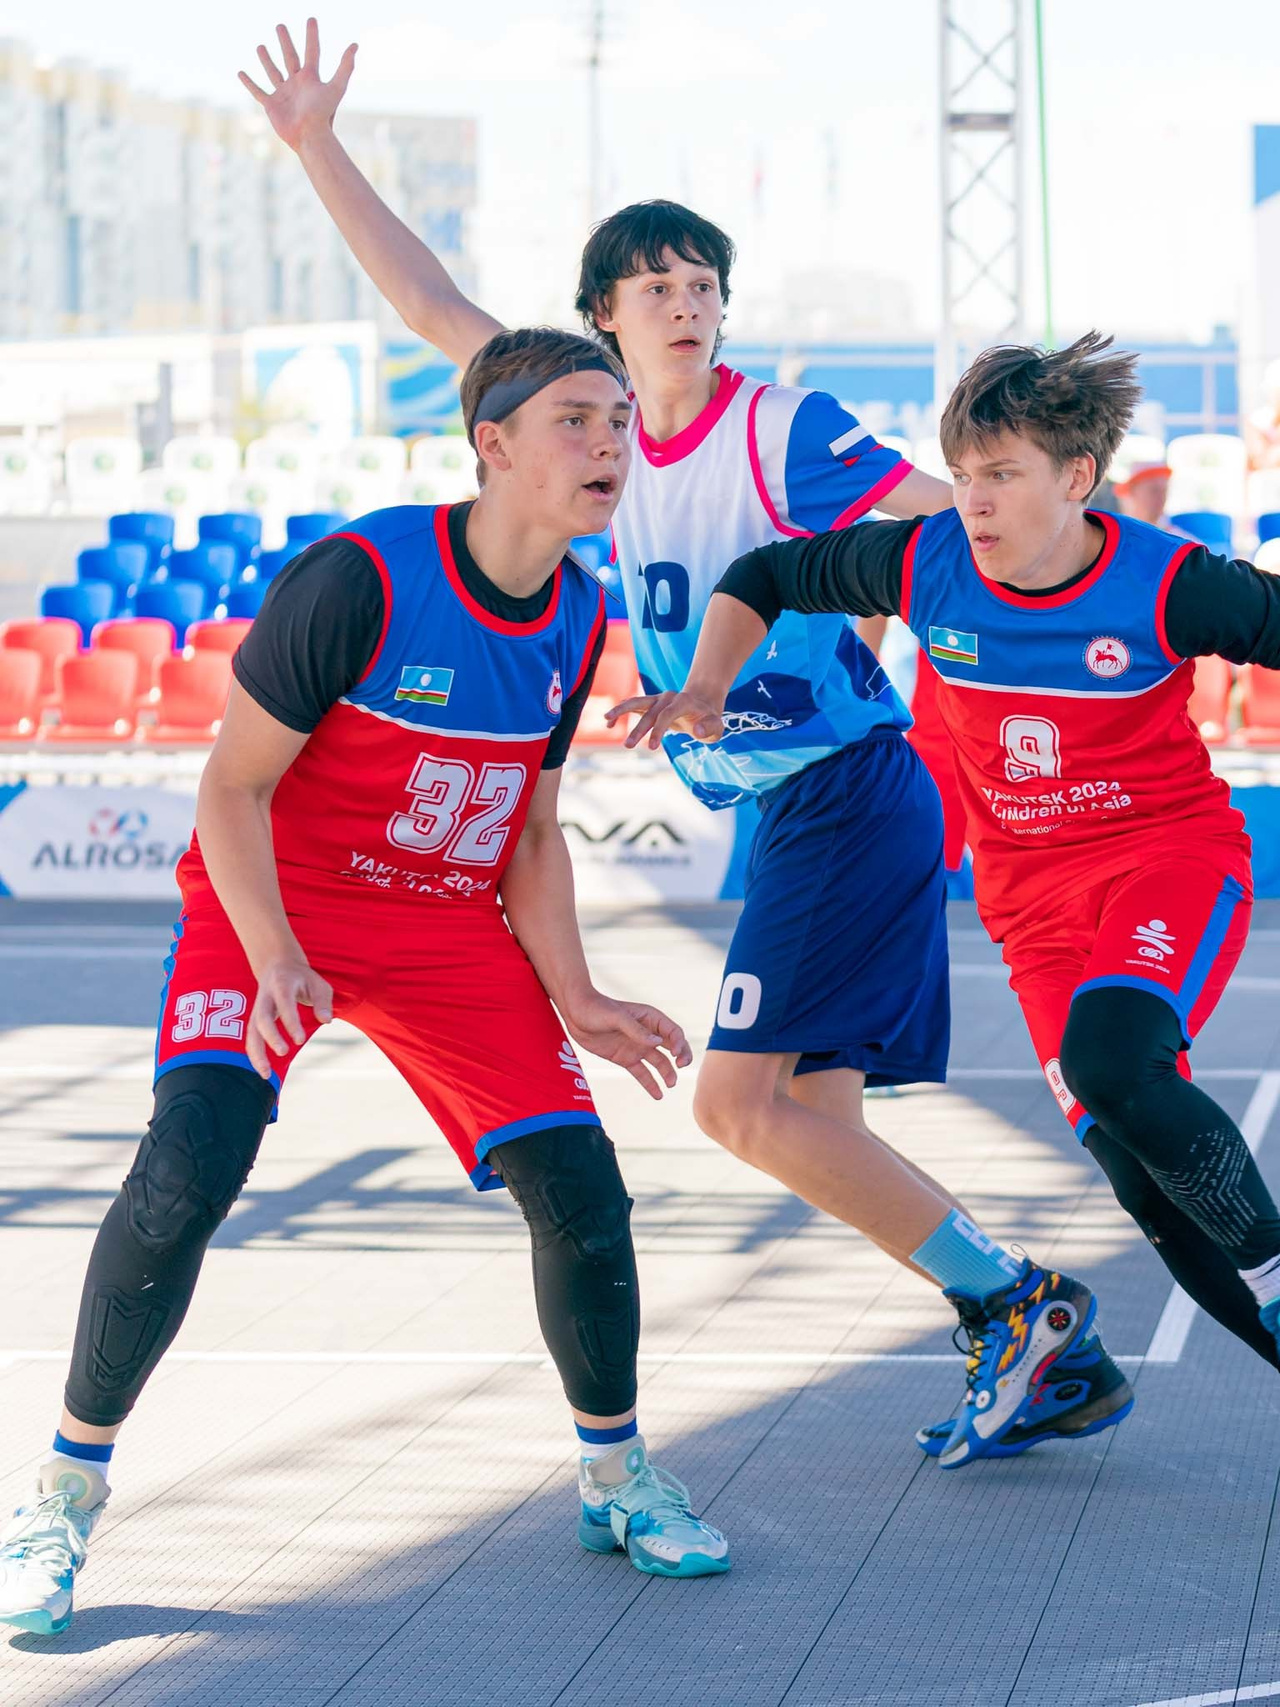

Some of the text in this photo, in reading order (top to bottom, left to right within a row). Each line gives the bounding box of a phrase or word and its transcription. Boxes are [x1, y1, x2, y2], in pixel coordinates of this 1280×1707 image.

[1000, 714, 1062, 782] 9
[386, 751, 527, 867] 32
[981, 781, 1121, 805] YAKUTSK 2024
[171, 980, 247, 1043] 32
[716, 971, 763, 1030] 0
